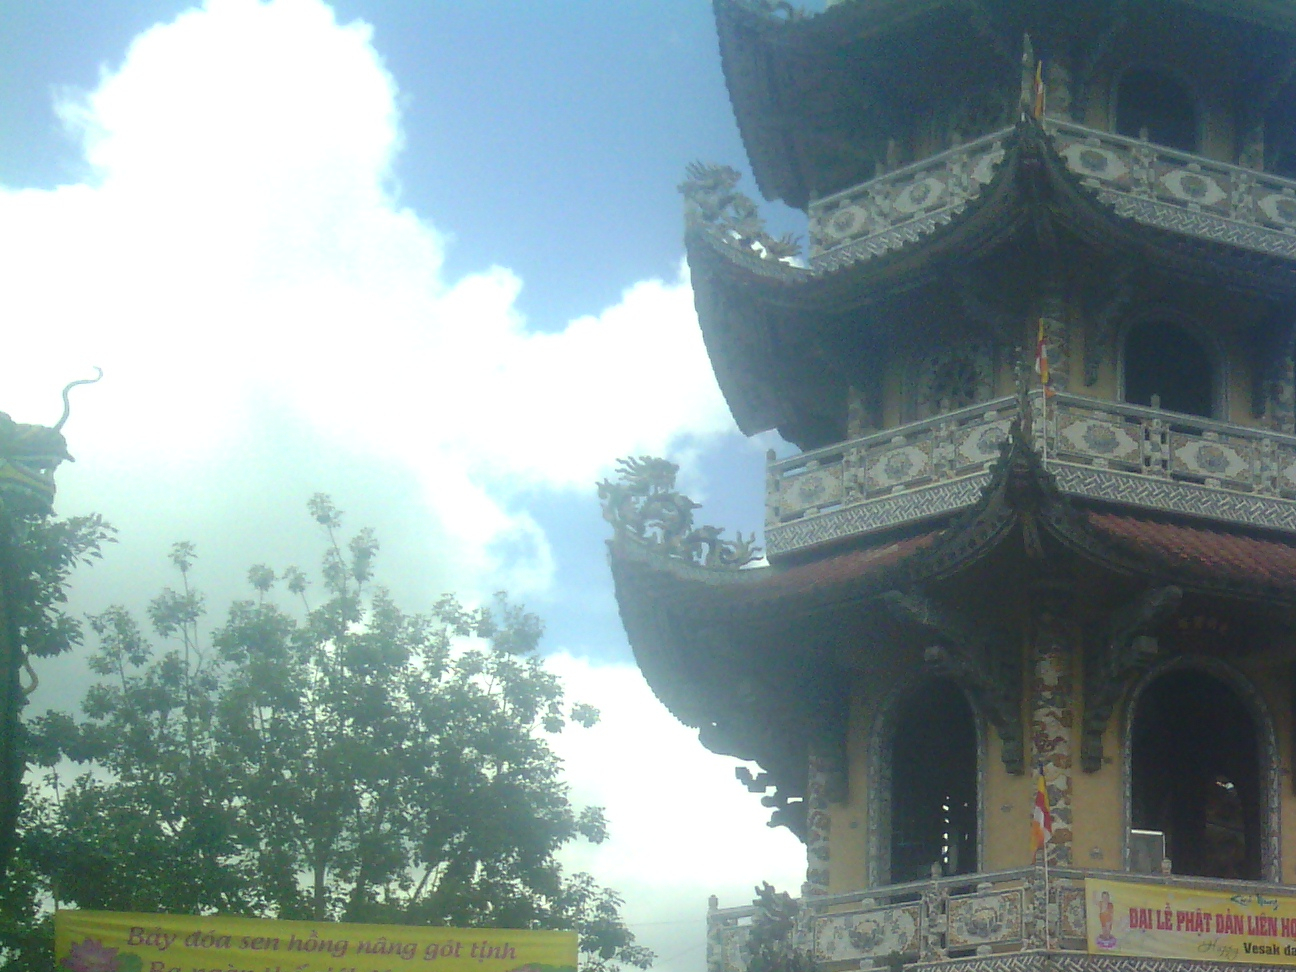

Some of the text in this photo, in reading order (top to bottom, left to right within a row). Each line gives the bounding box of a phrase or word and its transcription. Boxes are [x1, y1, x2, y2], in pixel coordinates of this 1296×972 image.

[1156, 902, 1173, 931] LỄ
[1176, 908, 1211, 937] PHẬT
[1246, 912, 1278, 938] LIÊN
[127, 926, 177, 951] Bảy
[184, 929, 233, 950] đóa
[238, 937, 280, 951] sen
[288, 929, 350, 957] hồng
[357, 936, 418, 960] nâng
[470, 940, 517, 963] tịnh
[1243, 942, 1280, 955] Vesak
